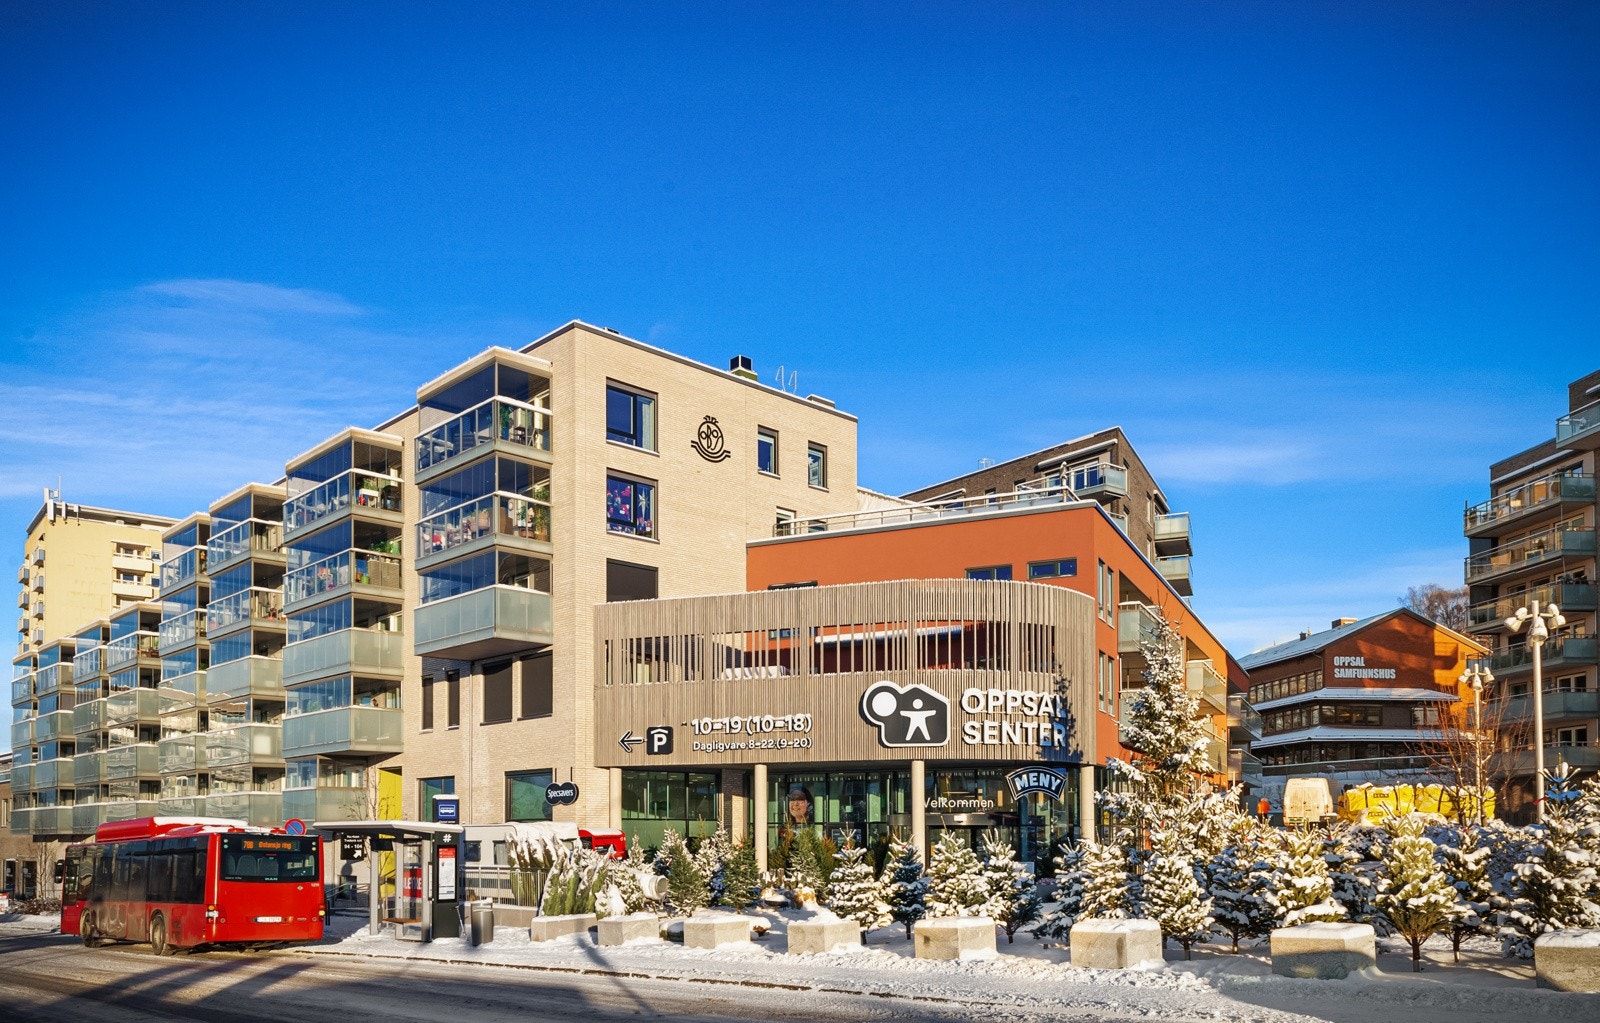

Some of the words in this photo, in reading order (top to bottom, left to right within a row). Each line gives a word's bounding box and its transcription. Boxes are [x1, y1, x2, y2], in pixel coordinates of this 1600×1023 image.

[1333, 656, 1365, 666] OPPSAL
[1334, 668, 1396, 679] SAMFUNNSHUS
[961, 688, 1066, 718] OPPSAL
[691, 716, 742, 735] 10-19
[746, 713, 813, 735] (10-18)
[962, 720, 1067, 747] SENTER
[653, 733, 668, 752] P
[693, 740, 746, 753] Dagligvare
[748, 739, 776, 749] 8-22
[776, 737, 813, 750] (9-20)
[1014, 772, 1061, 791] MENY
[547, 789, 574, 799] Specsavers
